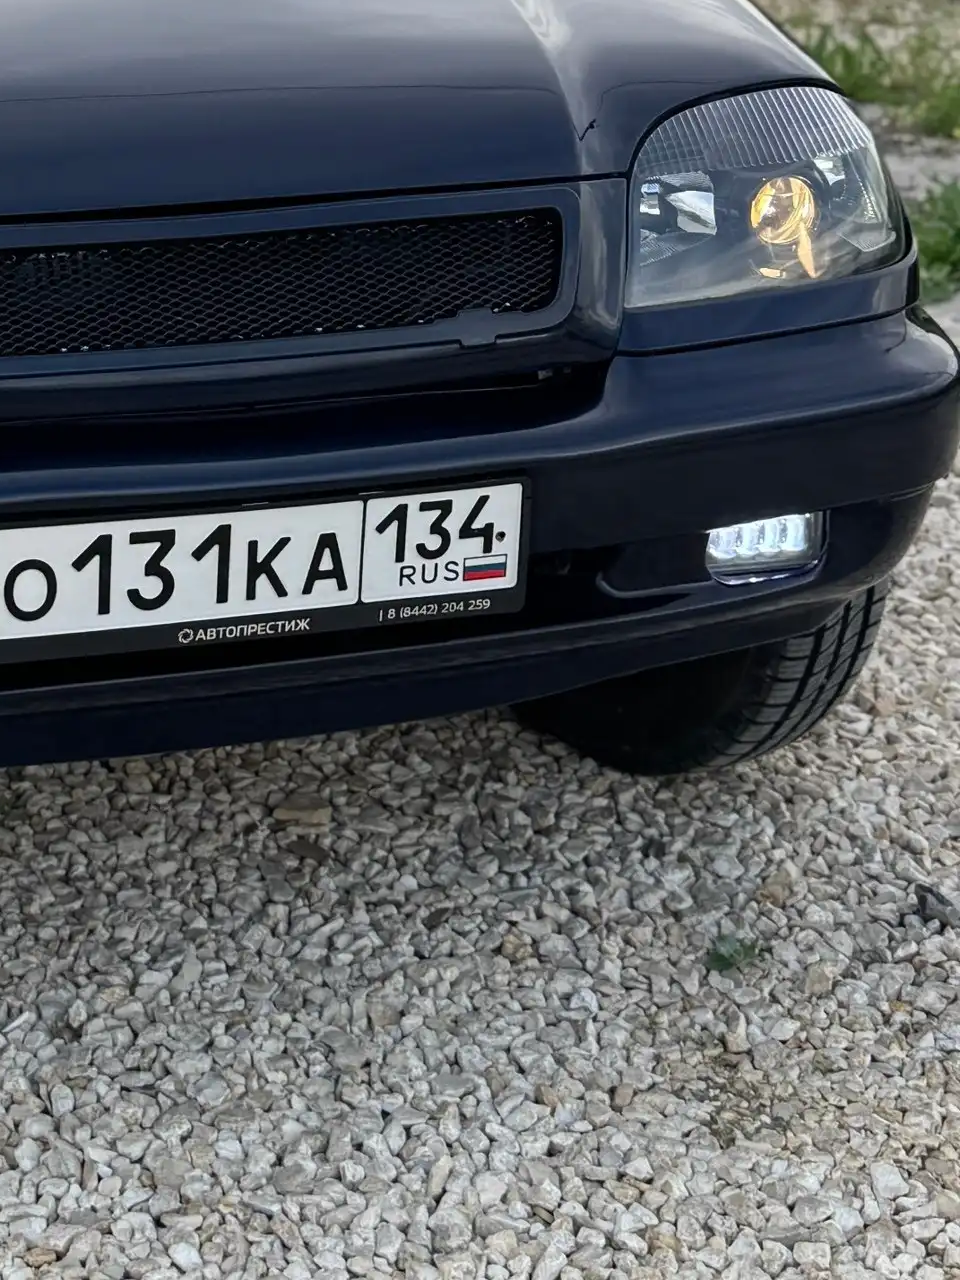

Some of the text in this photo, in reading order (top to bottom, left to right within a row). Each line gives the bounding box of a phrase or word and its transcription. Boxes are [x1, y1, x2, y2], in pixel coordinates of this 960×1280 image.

[375, 495, 496, 564] 134
[398, 560, 460, 587] RUS
[387, 598, 491, 620] 8 (8442) 204 259
[194, 618, 311, 642] АВТОПРЕСТИЖ
